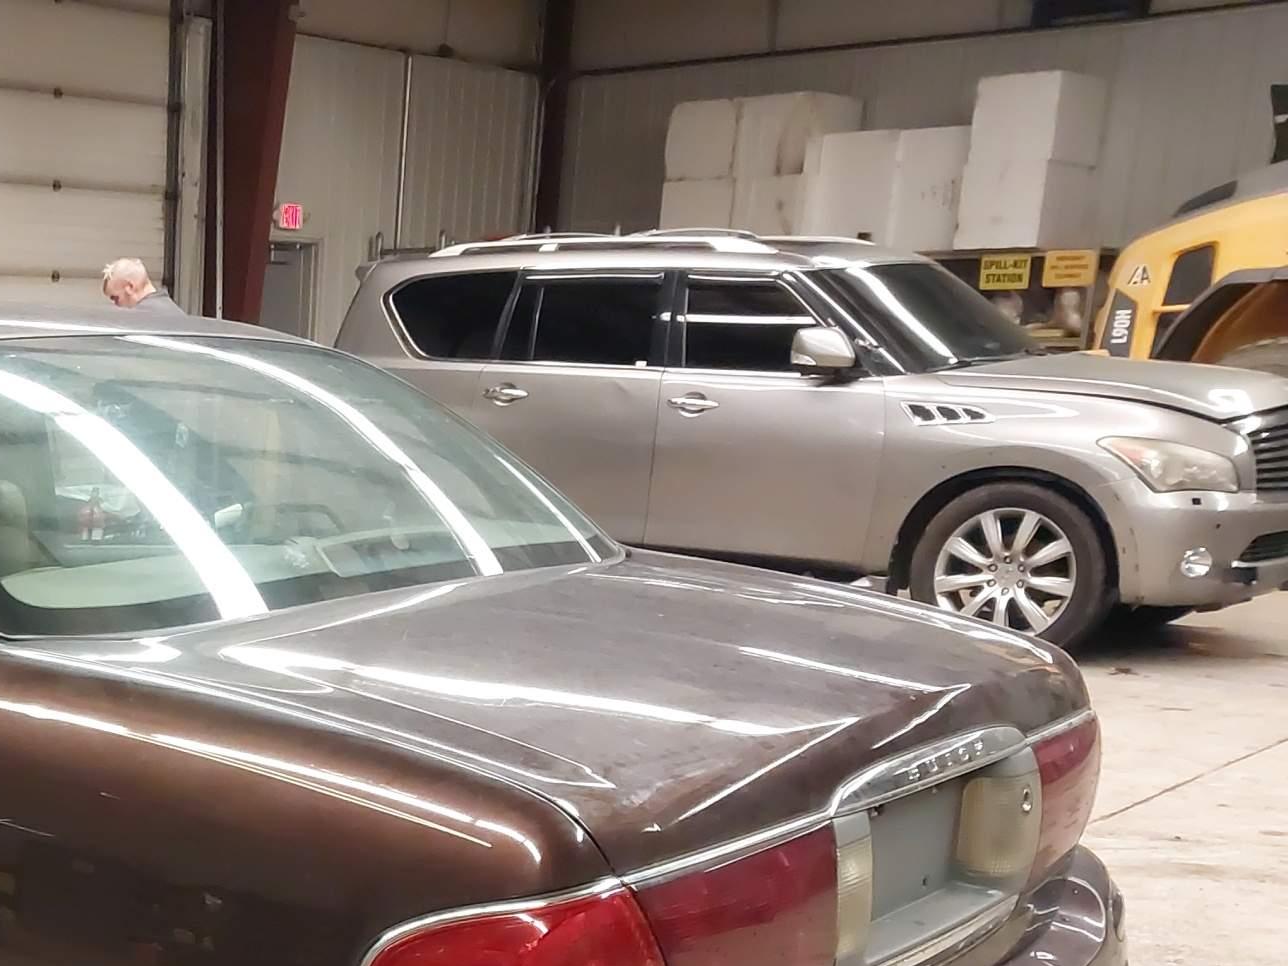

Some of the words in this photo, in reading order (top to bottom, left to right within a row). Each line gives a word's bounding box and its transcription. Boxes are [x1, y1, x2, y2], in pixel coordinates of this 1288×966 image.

[983, 259, 1028, 270] SPILL-KIT
[984, 273, 1024, 284] STATION
[1110, 309, 1132, 344] L90H
